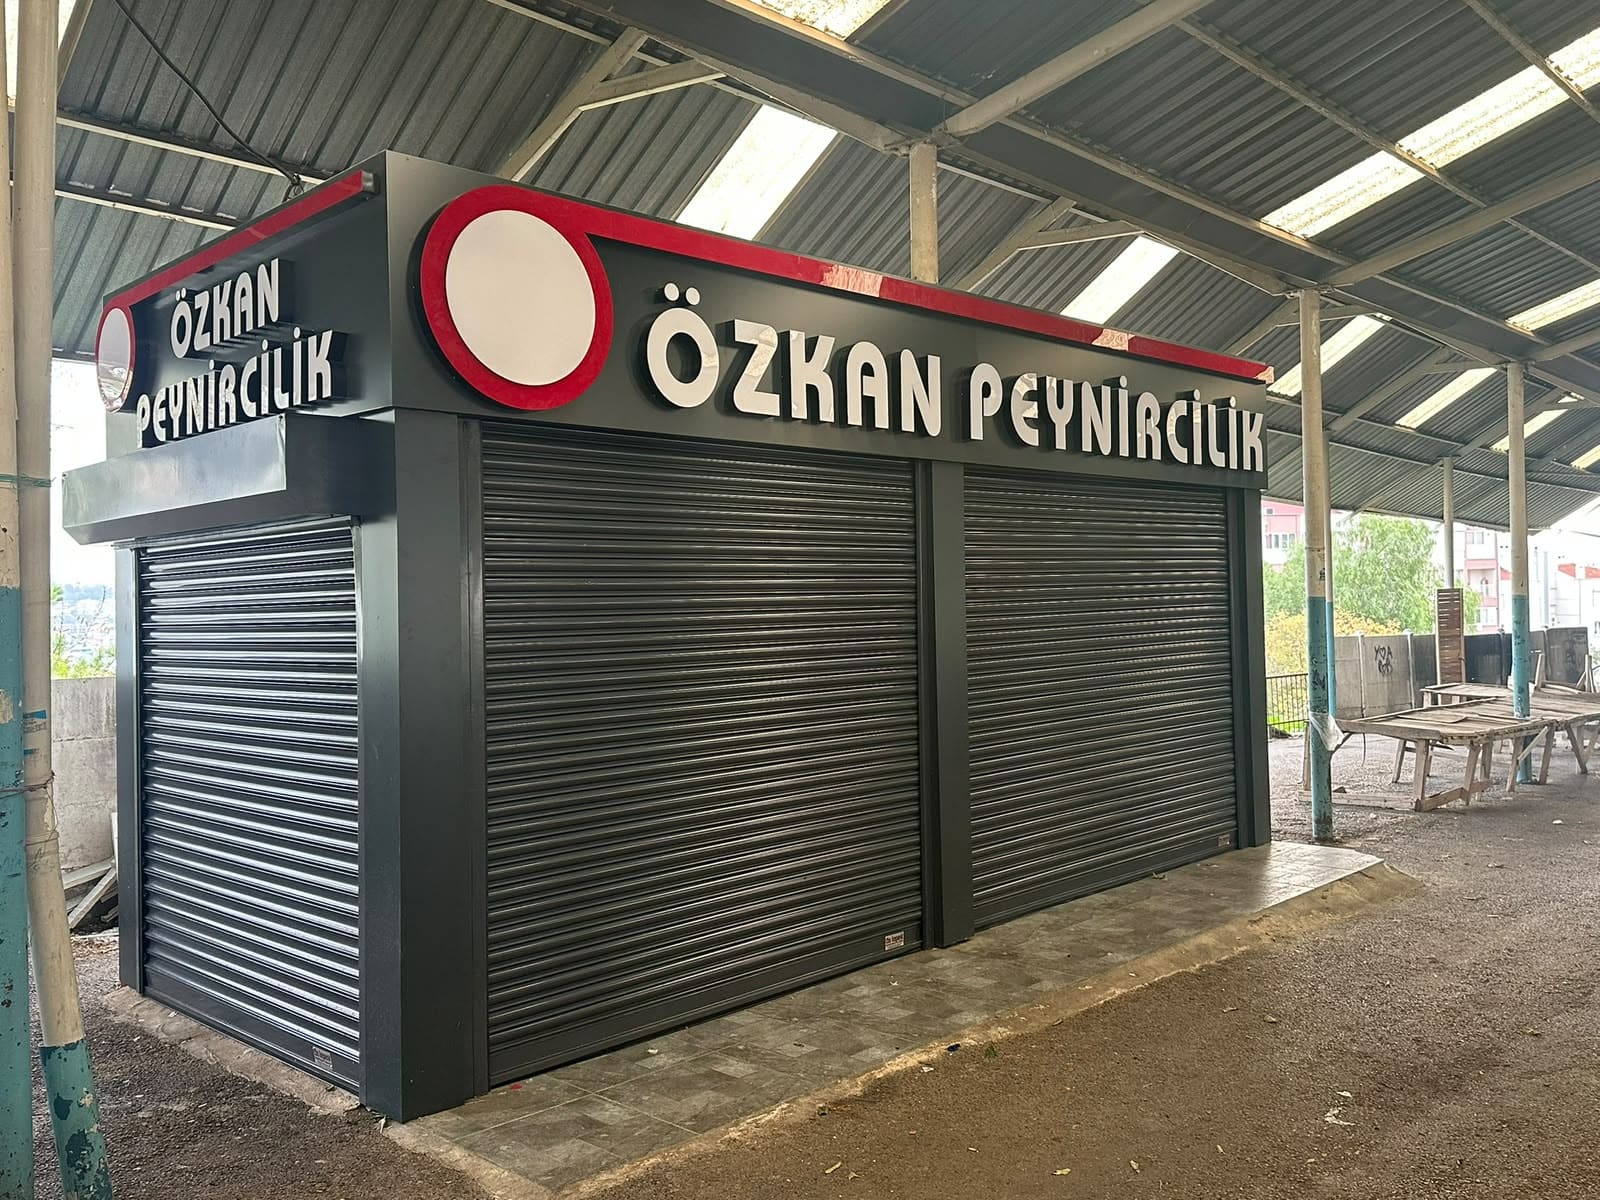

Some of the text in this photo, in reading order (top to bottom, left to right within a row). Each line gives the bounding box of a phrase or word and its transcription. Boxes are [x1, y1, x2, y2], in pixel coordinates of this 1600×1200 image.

[170, 257, 279, 359] ÖZKAN
[136, 326, 333, 449] PEYNİRCİLİK
[646, 282, 1264, 472] ÖZKAN PEYNİRCİLİK
